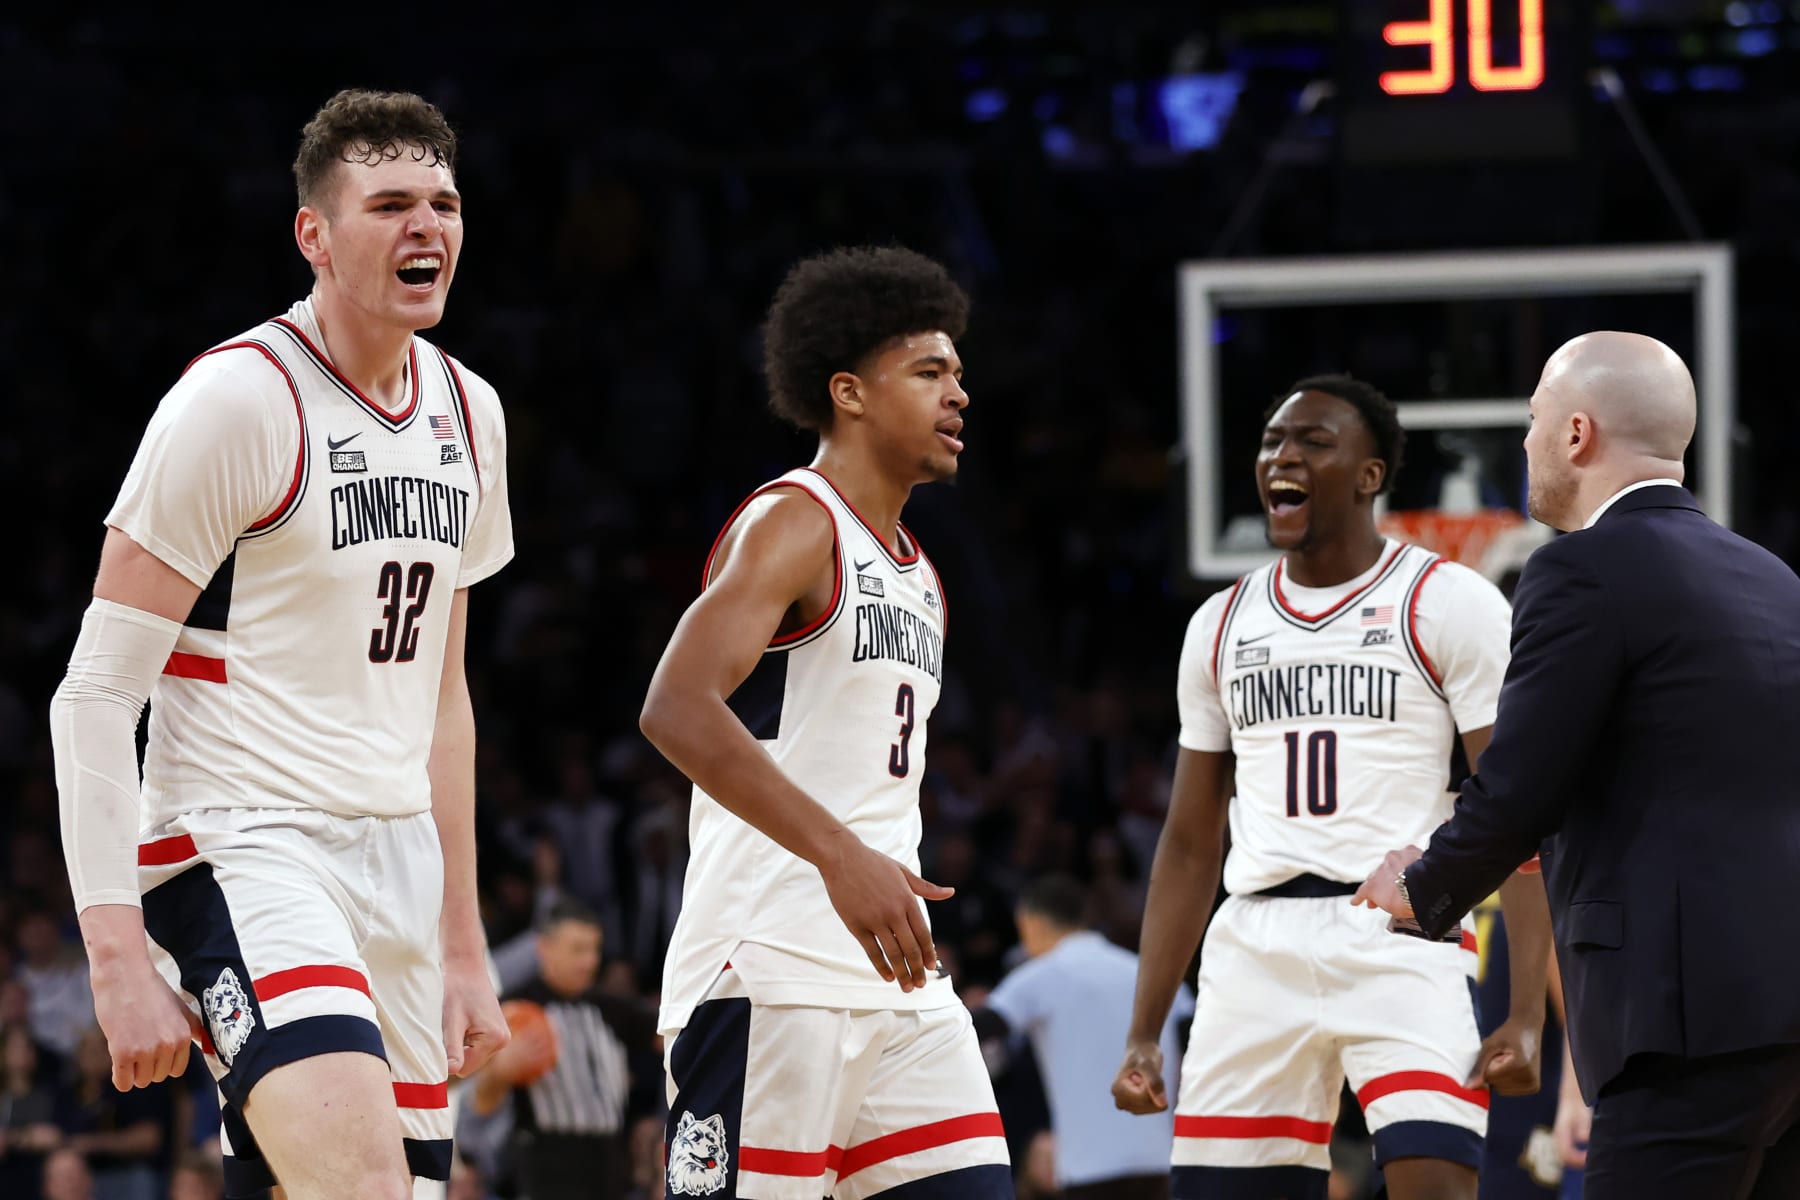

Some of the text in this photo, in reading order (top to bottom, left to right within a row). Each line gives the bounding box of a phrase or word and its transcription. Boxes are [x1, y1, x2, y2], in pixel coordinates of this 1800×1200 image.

[1379, 0, 1545, 95] 30
[332, 463, 366, 471] CHANGE
[338, 453, 353, 463] BE
[440, 452, 463, 461] EAST
[441, 444, 456, 453] BIG
[330, 476, 469, 551] CONNECTICUT
[368, 561, 434, 663] 32
[888, 682, 914, 779] 3
[1231, 664, 1401, 731] CONNECTICUT
[1284, 730, 1337, 818] 10
